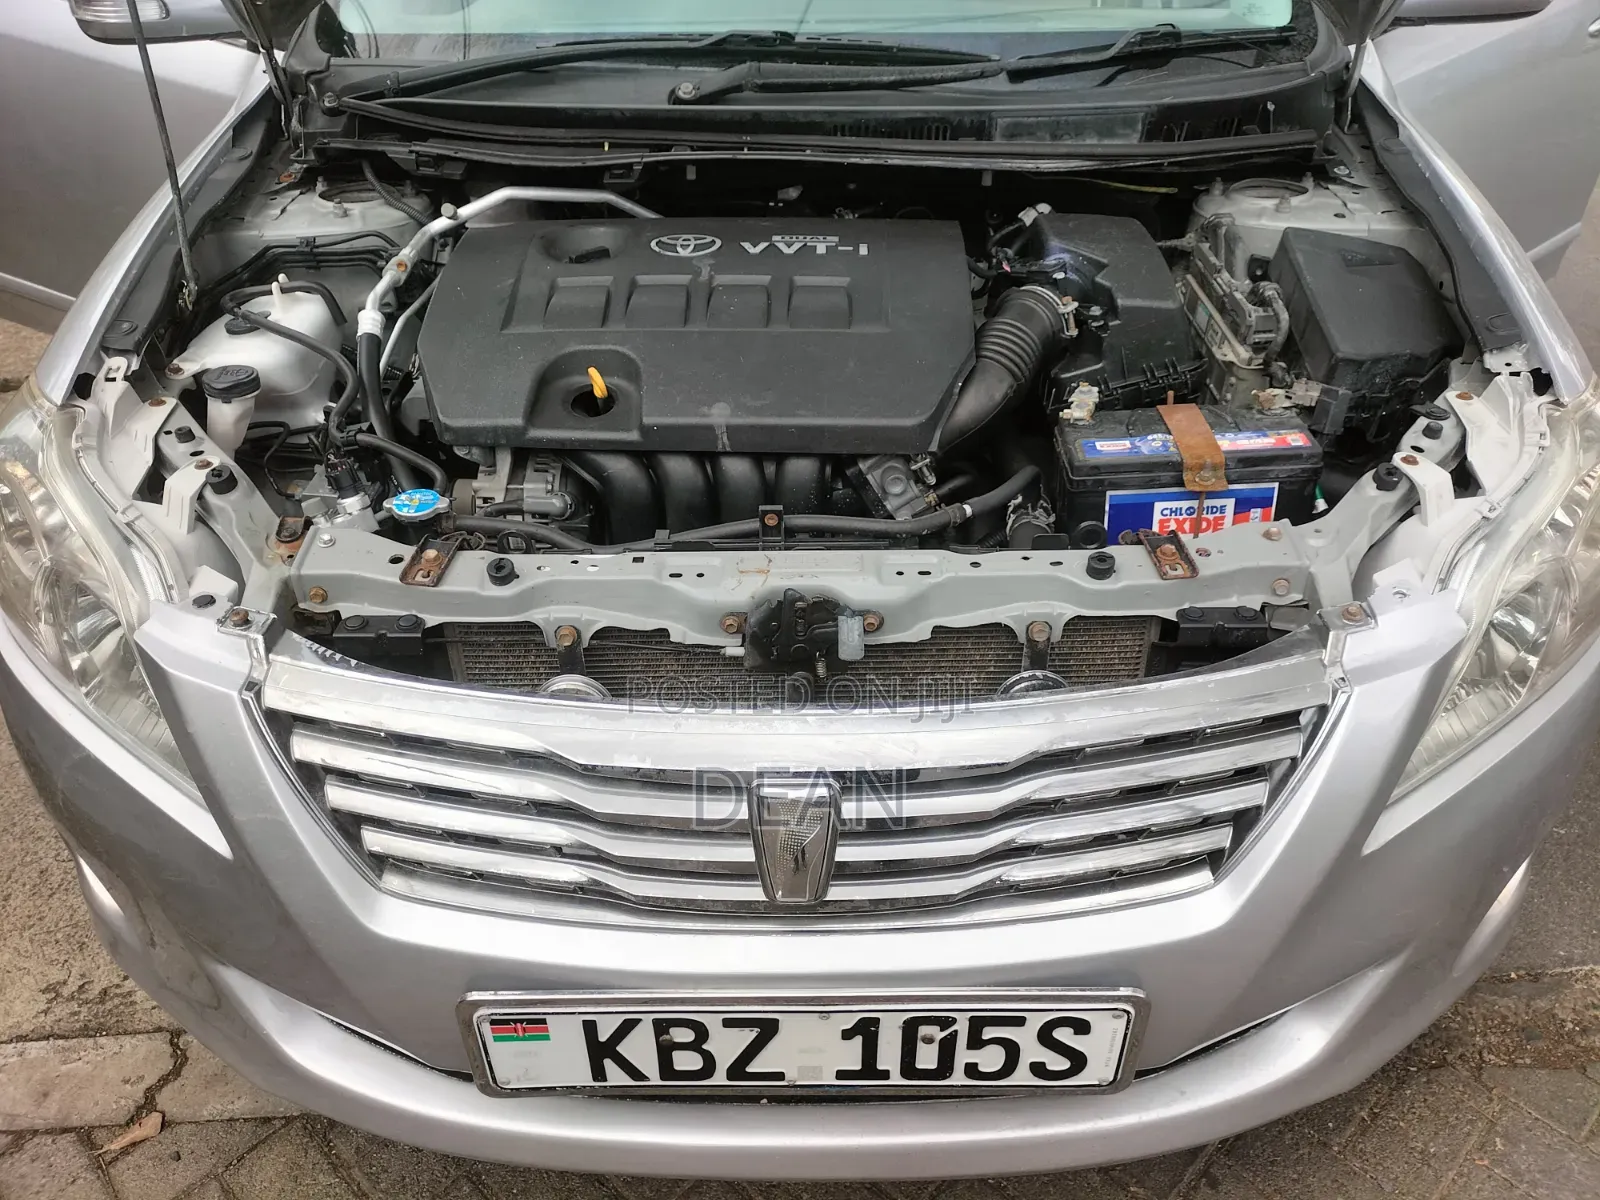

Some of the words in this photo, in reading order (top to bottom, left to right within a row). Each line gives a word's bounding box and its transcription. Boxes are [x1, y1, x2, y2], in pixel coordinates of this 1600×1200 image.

[1158, 515, 1227, 536] EXIDE
[582, 1017, 786, 1083] KBZ
[835, 1015, 1092, 1082] 105S
